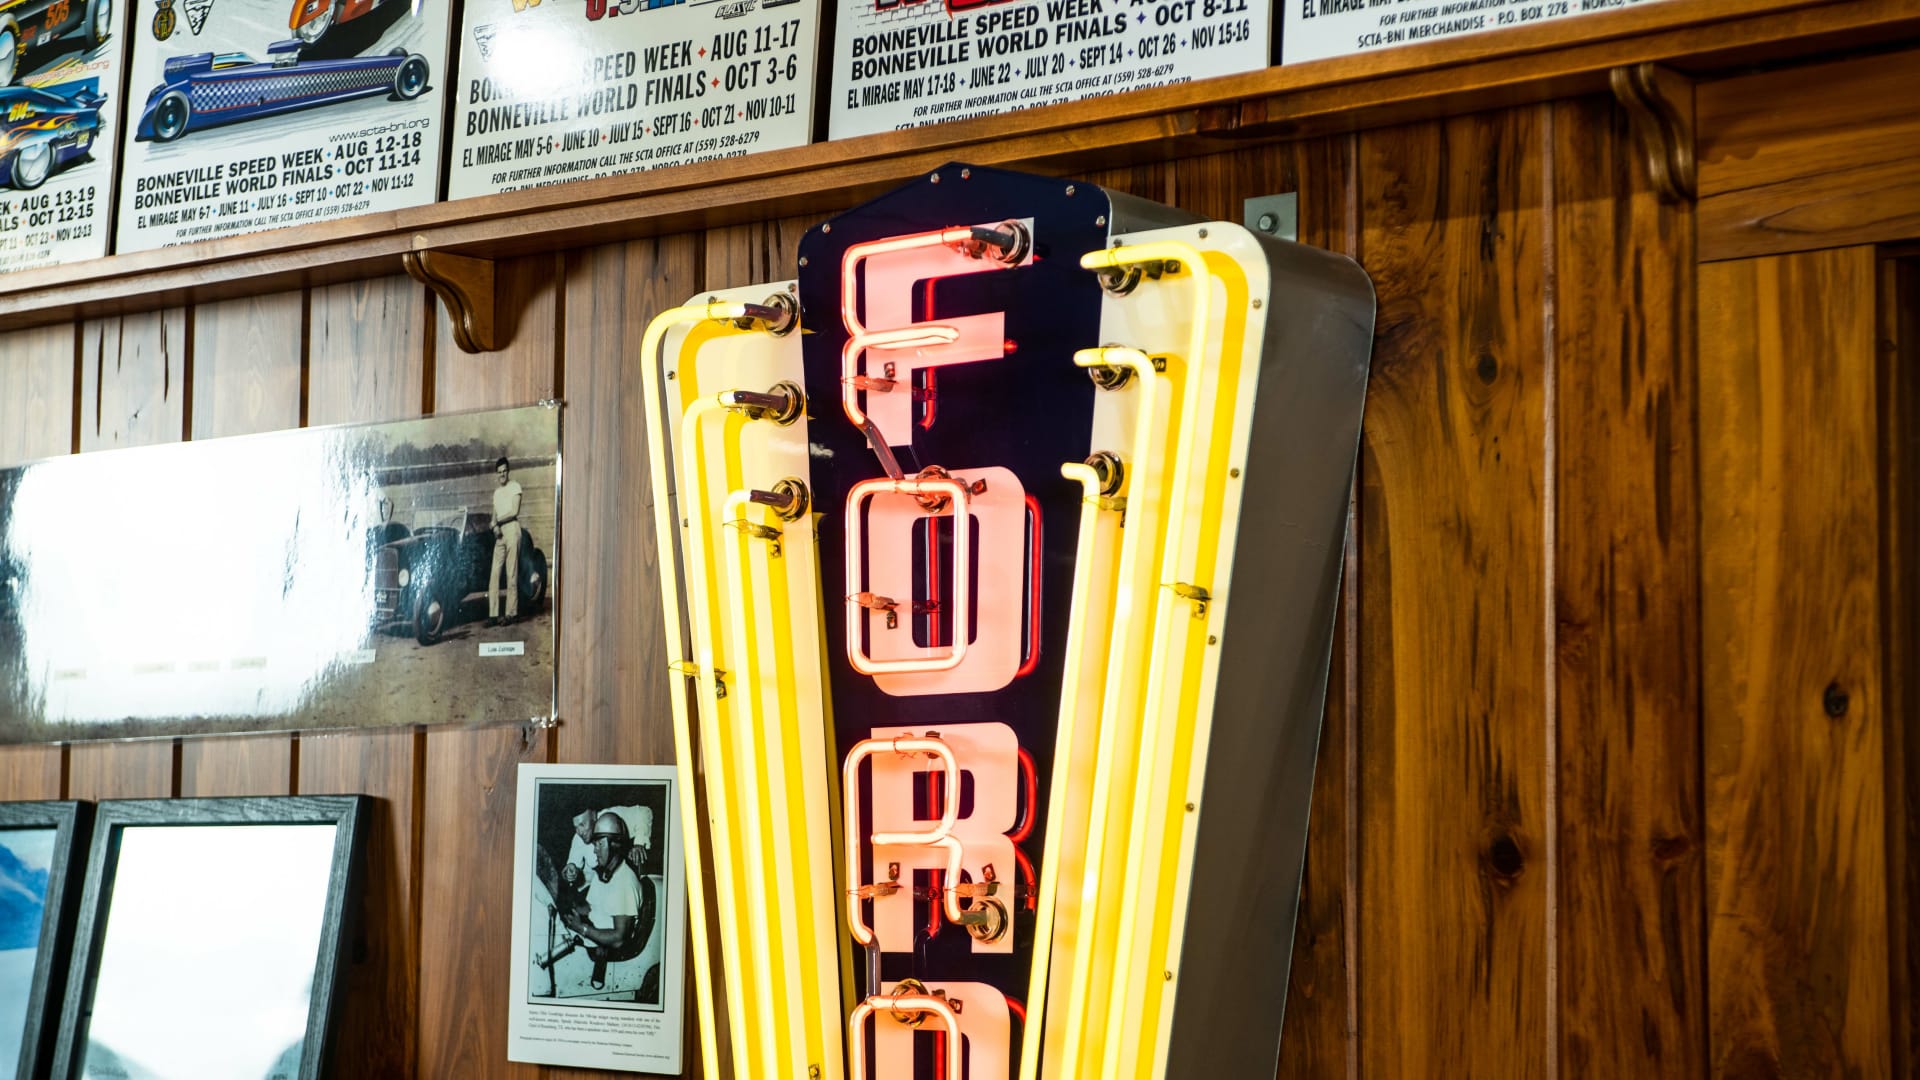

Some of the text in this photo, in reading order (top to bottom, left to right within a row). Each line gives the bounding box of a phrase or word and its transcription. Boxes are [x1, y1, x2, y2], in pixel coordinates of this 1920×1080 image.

[852, 0, 1103, 58] BONNEVILLE SPEED WEEK
[1303, 0, 1316, 19] EL
[1358, 28, 1405, 48] SCTA-BNI
[1409, 15, 1485, 39] MERCHANDISE
[1498, 11, 1517, 25] P.O.
[1521, 5, 1543, 21] BOX
[1548, 2, 1568, 17] 278
[1380, 14, 1397, 26] FOR
[1400, 6, 1438, 22] FURTHER
[644, 39, 693, 74] WEEK
[711, 29, 748, 61] AUG
[754, 19, 801, 53] 11-17
[848, 19, 1250, 109] EL MIRAGE MAY 17-18 JUNE 22 JULY 20 SEPT 14 OCT 26 NOV 15-16
[852, 41, 970, 81] BONNEVILLE
[977, 28, 1049, 59] WORLD
[1055, 12, 1128, 45] FINALS
[1155, 0, 1196, 26] OCT
[467, 53, 798, 136] BONNEVILLE WORLD FINALS OCT 3-6
[914, 106, 928, 117] FOR
[930, 100, 962, 115] FURTHER
[964, 91, 1018, 108] INFORMATION
[1020, 87, 1037, 99] CALL
[1039, 84, 1053, 96] THE
[1055, 81, 1073, 94] SCTA
[1075, 77, 1100, 90] OFFICE
[1102, 74, 1113, 85] AT
[1114, 70, 1135, 86] (559)
[1137, 64, 1174, 79] 528-6279
[329, 118, 430, 143] www.scta-bni.org
[463, 93, 795, 168] EL MIRAGE MAY 5-6 JUNE 10 JULY 15 SEPT 16 OCT 21 NOV 10-11
[134, 149, 421, 209] BONNEVILLE WORLD FINALS OCT 11-14
[136, 131, 422, 193] BONNEVILLE SPEED WEEK AUG 12-18
[491, 172, 506, 184] FOR
[509, 167, 542, 182] FURTHER
[544, 158, 597, 176] INFORMATION
[600, 156, 616, 167] CALL
[619, 153, 633, 164] THE
[635, 149, 653, 161] SCTA
[656, 144, 681, 157] OFFICE
[683, 142, 694, 153] AT
[695, 138, 718, 154] (559)
[720, 131, 760, 148] 528-6279
[21, 194, 49, 212] AUG
[55, 186, 94, 206] 13-19
[29, 210, 54, 227] OCT
[58, 203, 93, 222] 12-15
[138, 173, 414, 229] EL MIRAGE MAY 6-7 JUNE 11 JULY 16 SEPT 10 OCT 22 NOV 11-12
[176, 229, 187, 238] FOR
[189, 225, 212, 236] FURTHER
[214, 219, 253, 232] INFORMATION
[254, 216, 267, 226] CALL
[269, 214, 279, 223] THE
[280, 211, 294, 222] SCTA
[295, 208, 313, 220] OFFICE
[315, 207, 323, 216] AT
[324, 205, 340, 216] (559)
[56, 227, 71, 242] NOV
[73, 224, 92, 239] 12-13
